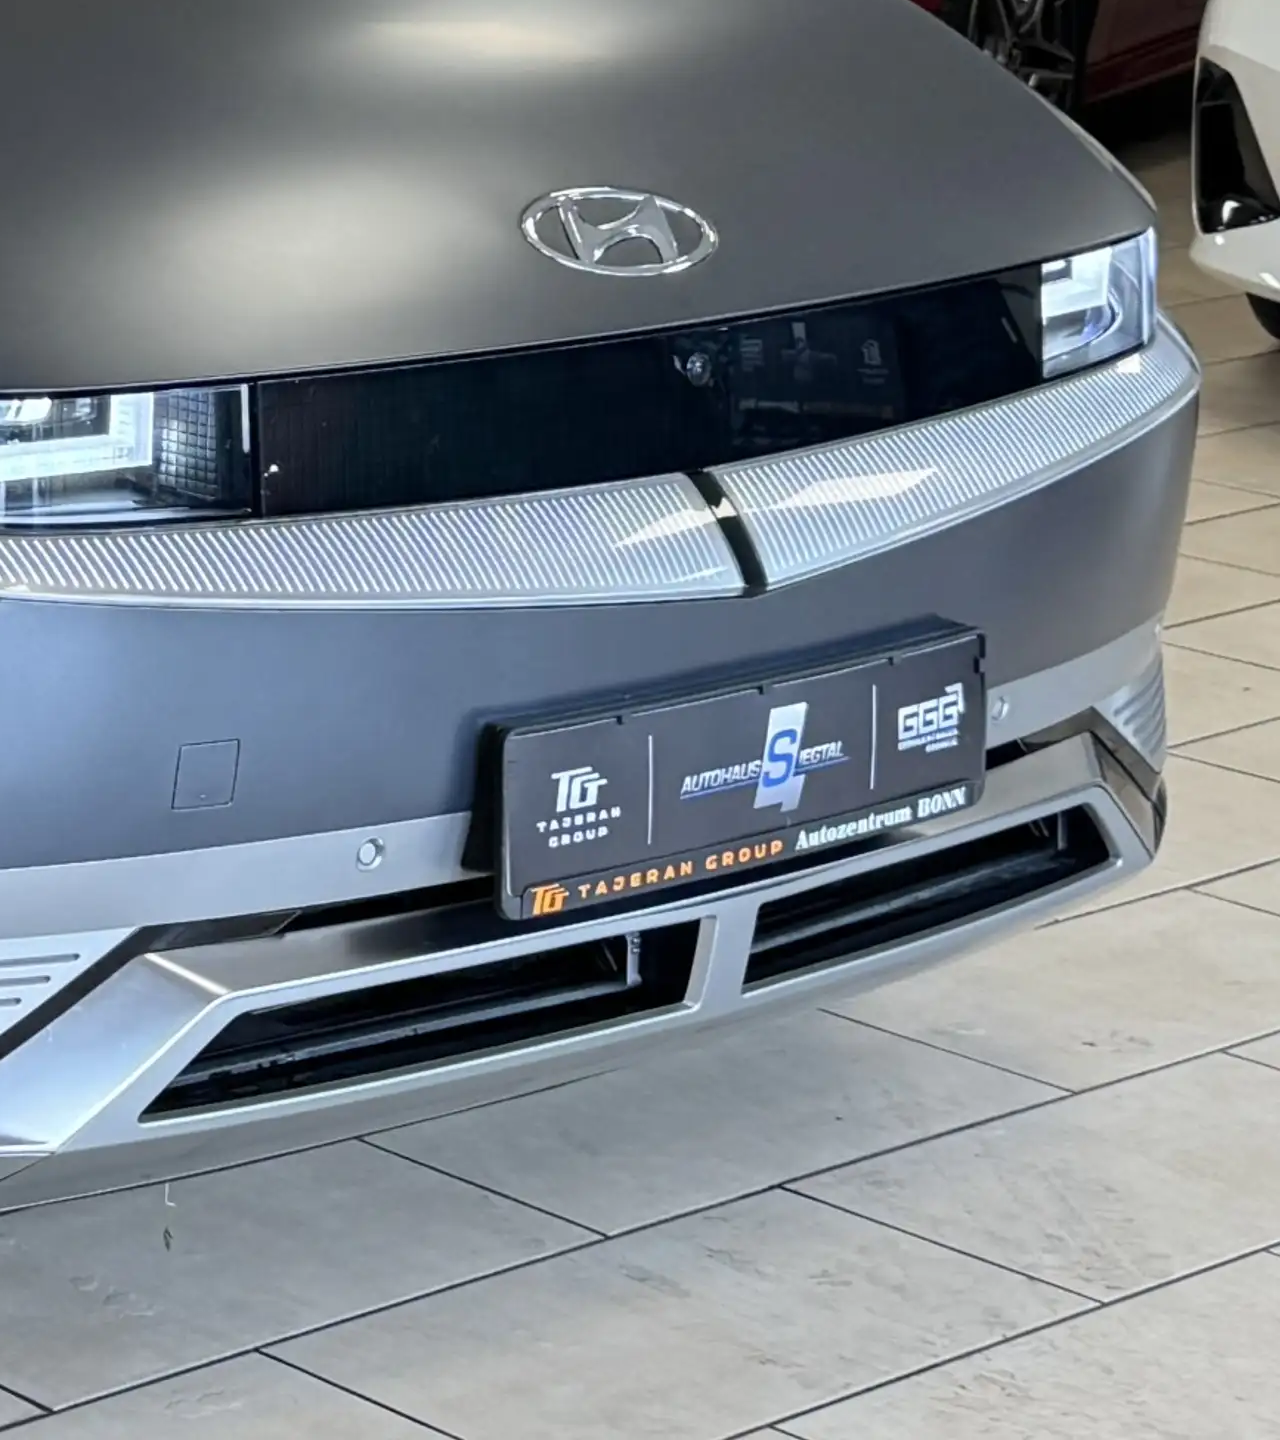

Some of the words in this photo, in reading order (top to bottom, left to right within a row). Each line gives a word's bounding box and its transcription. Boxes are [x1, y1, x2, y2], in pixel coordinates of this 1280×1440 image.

[897, 694, 959, 741] GGG
[680, 759, 763, 796] AUTOHAUS
[761, 727, 844, 788] SIEGTAL
[536, 806, 621, 833] TAJERAN
[548, 826, 608, 849] GROUP
[578, 860, 693, 899] TAJERAN
[705, 839, 784, 871] GROUP
[795, 806, 912, 851] Autozentrum
[917, 786, 967, 819] BONN
